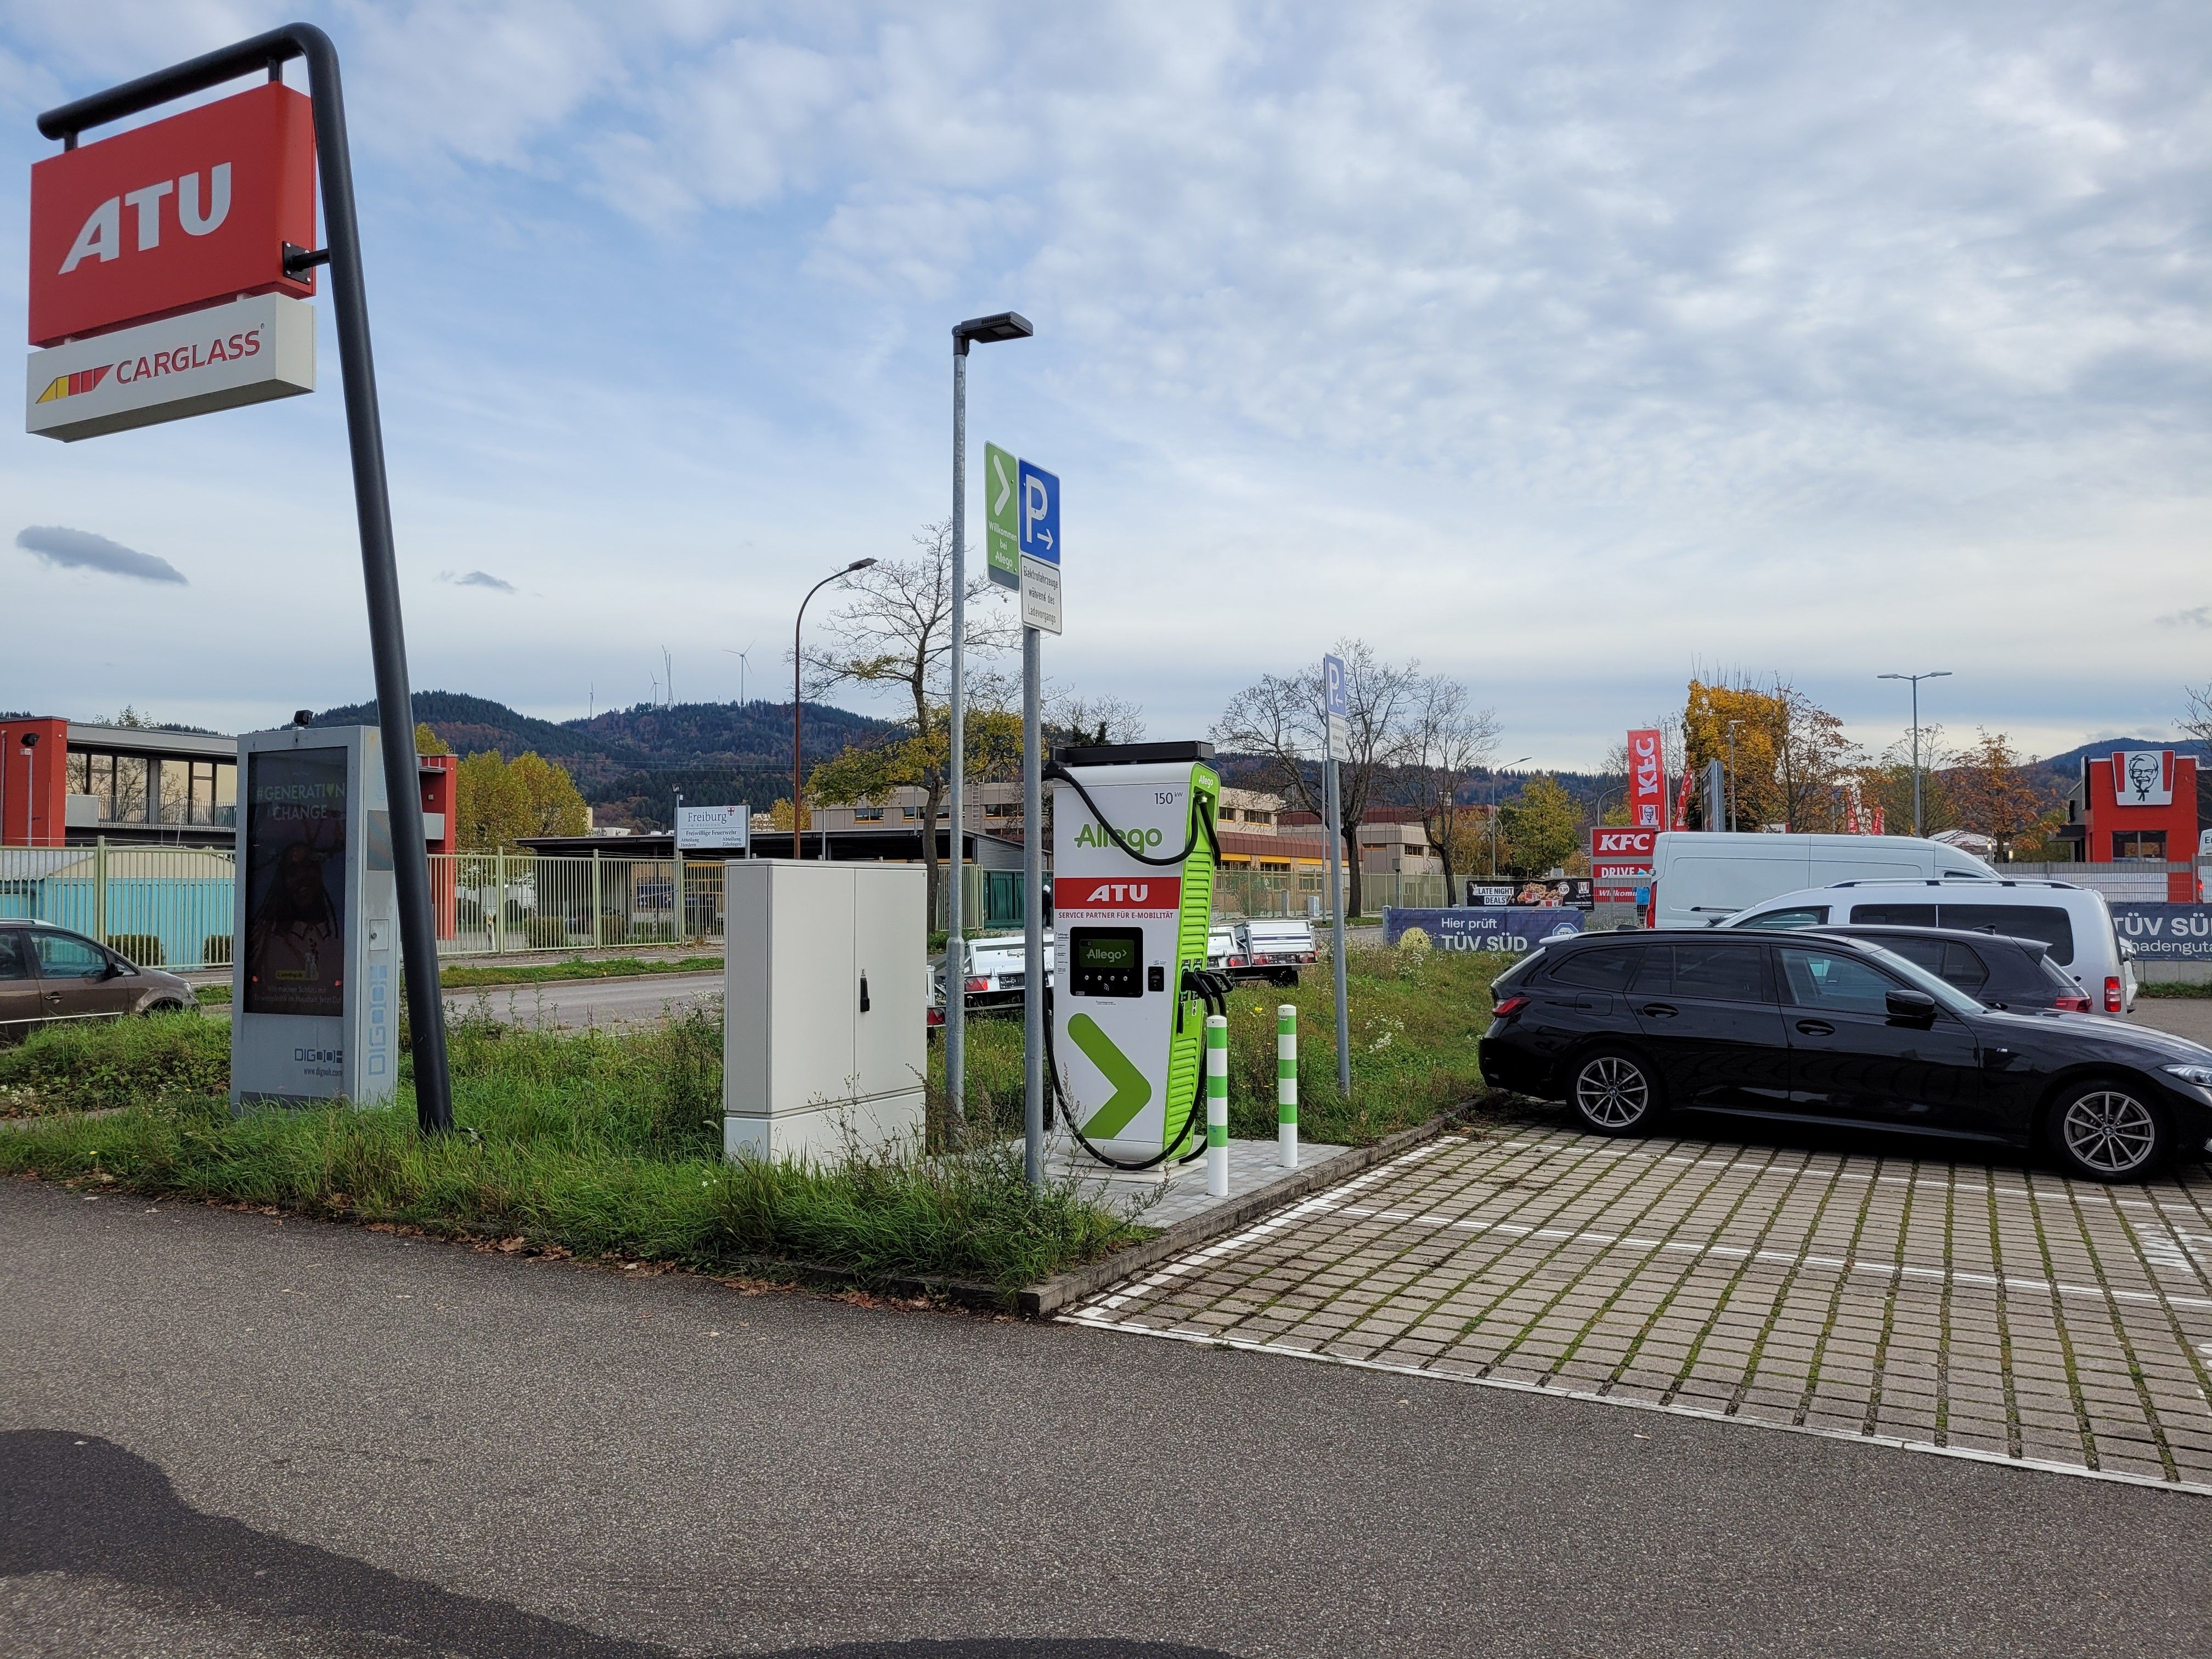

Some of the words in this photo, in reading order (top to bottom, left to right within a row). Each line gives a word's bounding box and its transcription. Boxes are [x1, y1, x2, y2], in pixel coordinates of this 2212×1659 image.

[58, 162, 232, 274] ATU
[116, 330, 261, 384] CARGLASS
[1025, 473, 1048, 544] P
[988, 520, 1018, 543] Willkommen
[999, 538, 1007, 550] bei
[995, 550, 1013, 569] Allego
[1023, 565, 1058, 590] Elektrofahrzeuge
[1028, 587, 1046, 602] während
[1028, 603, 1057, 625] Ladevorgangs
[1328, 662, 1340, 706] P
[1636, 737, 1658, 797] KFC
[1198, 775, 1214, 788] Allego
[1154, 792, 1173, 804] 150
[274, 804, 328, 821] CHANGE
[687, 811, 727, 824] Freiburg
[1074, 823, 1163, 855] Allego
[1599, 833, 1650, 851] KFC
[1601, 867, 1635, 878] DRIVE
[1086, 884, 1148, 902] ATU
[1116, 910, 1130, 919] FÜR
[1131, 910, 1174, 919] E-MOBILITÄT
[1441, 917, 1465, 928] Hier
[1468, 917, 1497, 931] prüft
[2170, 912, 2212, 936] SÜ
[1441, 931, 1482, 951] TÜV
[1486, 932, 1528, 952] SÜD
[1086, 949, 1122, 963] Allego
[303, 1067, 343, 1077] www.digooh.com
